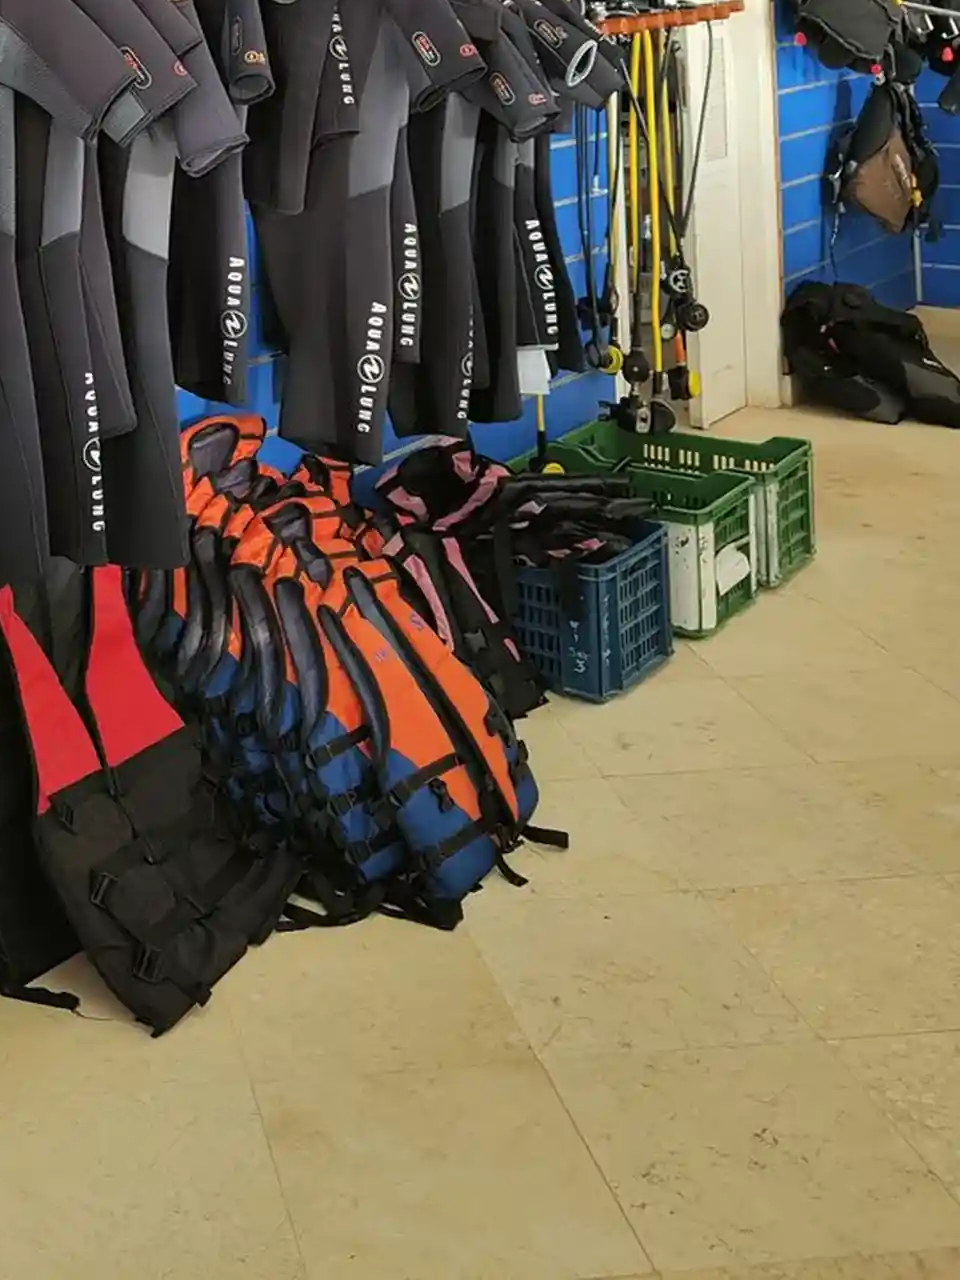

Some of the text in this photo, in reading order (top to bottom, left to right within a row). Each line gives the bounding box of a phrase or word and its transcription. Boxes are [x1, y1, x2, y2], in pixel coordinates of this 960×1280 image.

[338, 62, 355, 105] LUNG
[226, 256, 245, 306] AQUA
[399, 222, 418, 346] AQUA LUNG
[525, 219, 559, 335] AQUA LUNG
[357, 301, 387, 433] AQUA LUNG
[91, 475, 106, 532] LUNG
